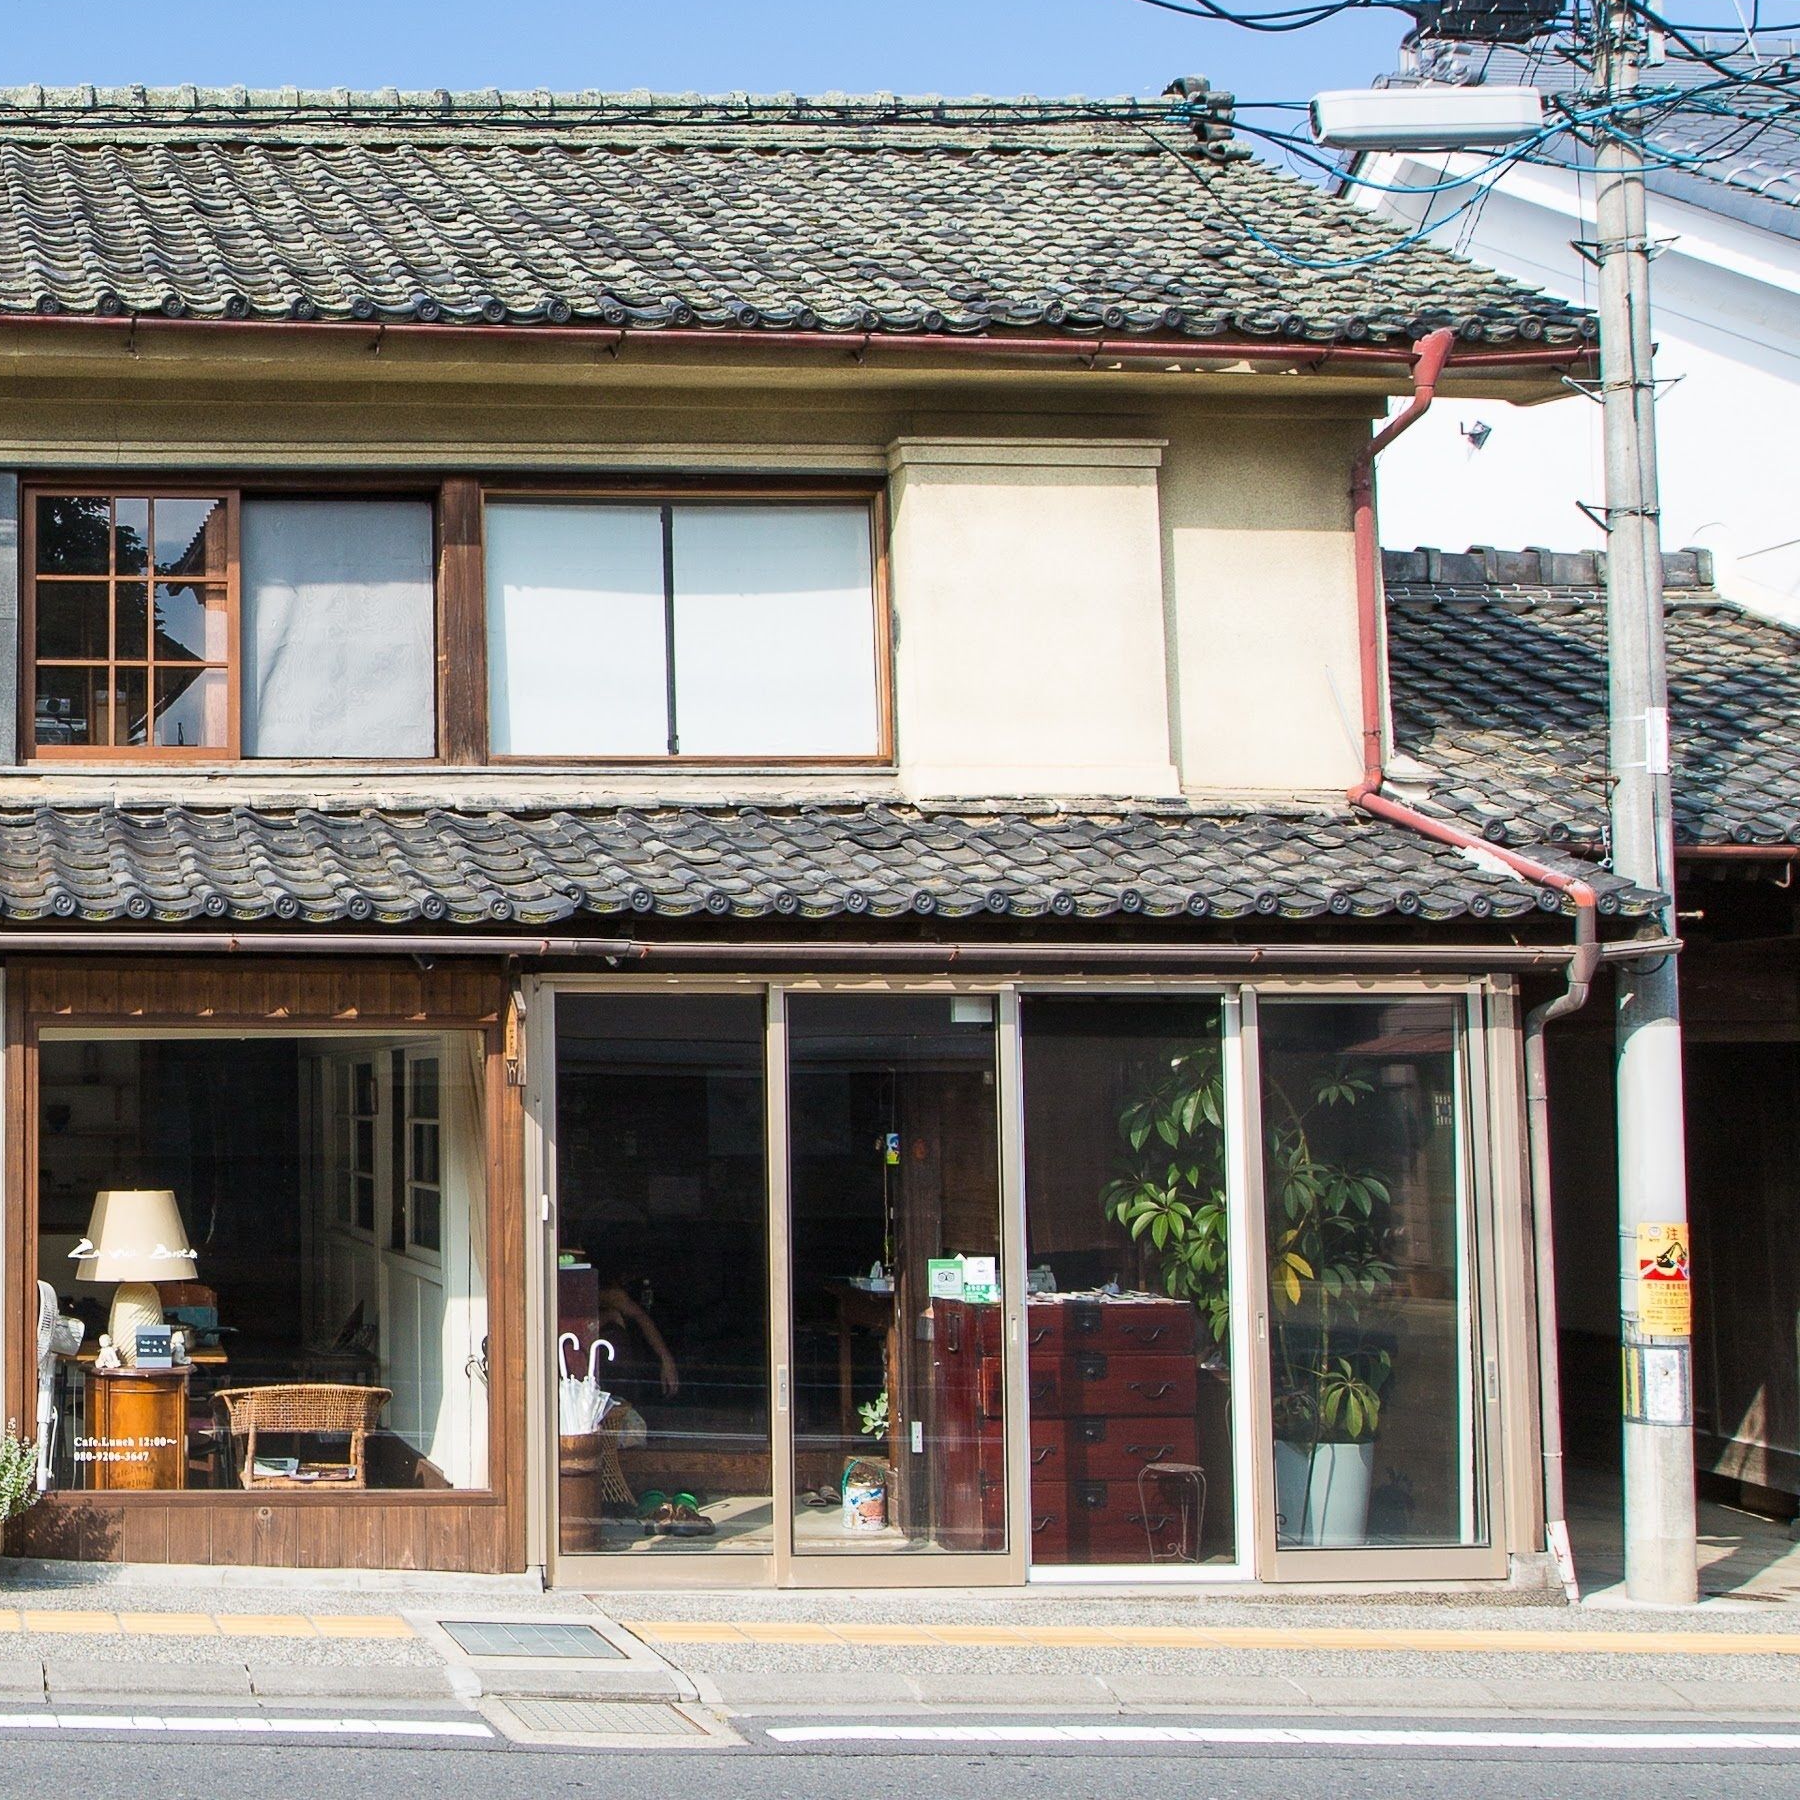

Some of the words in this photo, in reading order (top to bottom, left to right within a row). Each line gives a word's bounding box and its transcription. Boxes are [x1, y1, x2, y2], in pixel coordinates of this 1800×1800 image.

[68, 1237, 100, 1259] La
[73, 1436, 135, 1447] Cafe.Lunch
[73, 1451, 150, 1462] 080-9206-3647
